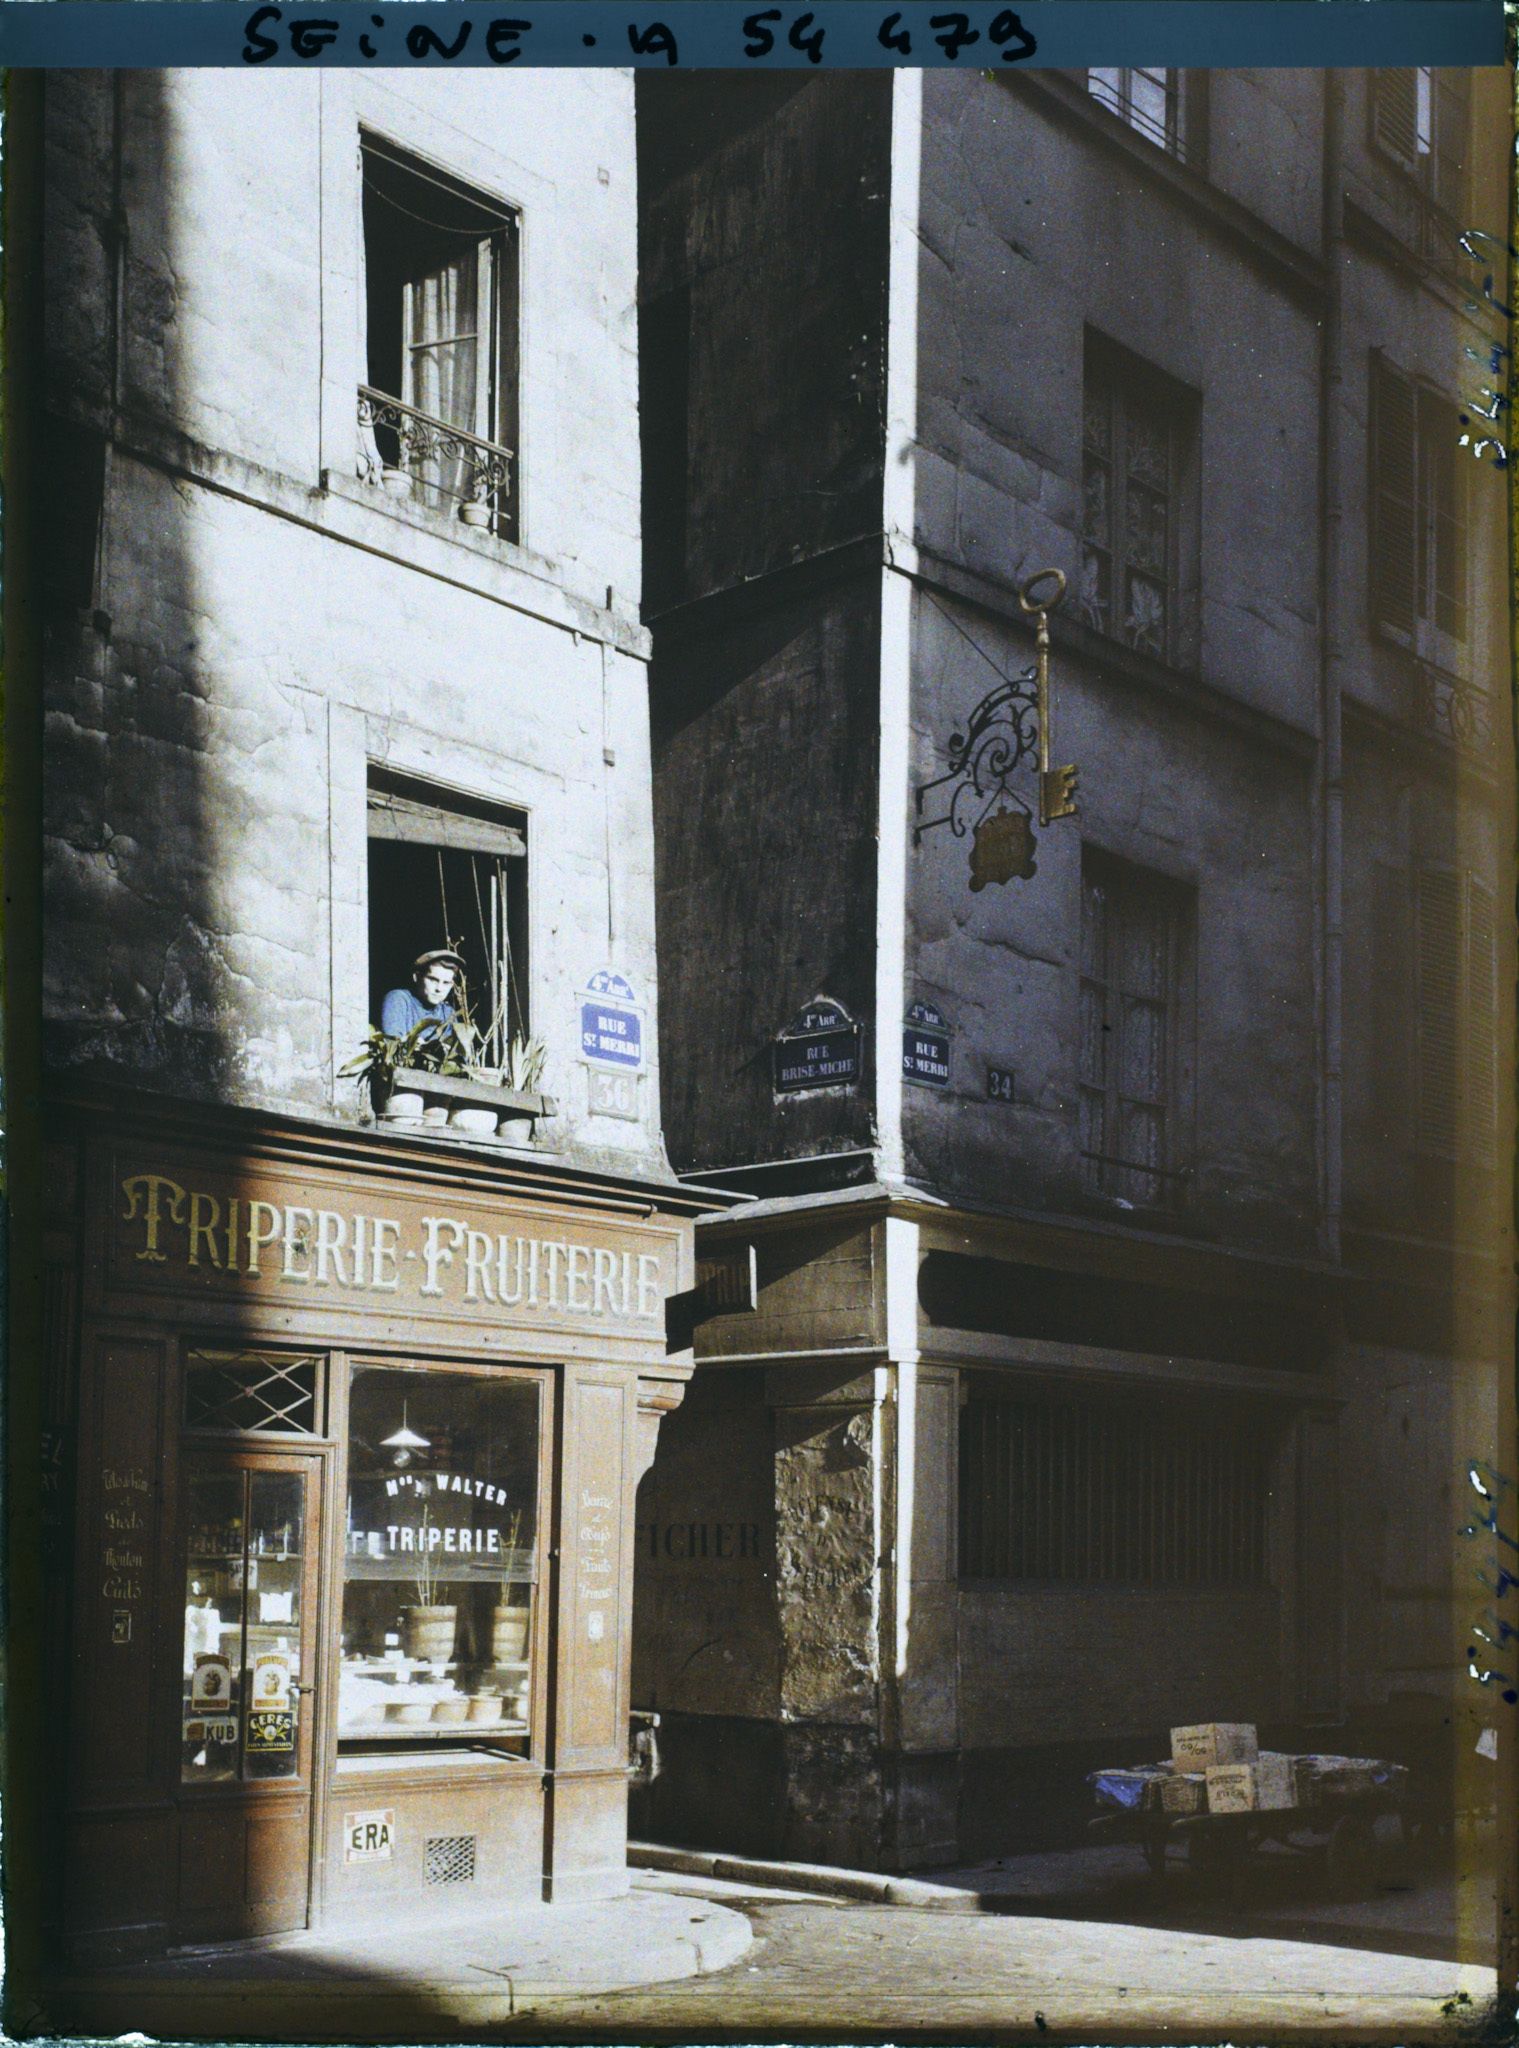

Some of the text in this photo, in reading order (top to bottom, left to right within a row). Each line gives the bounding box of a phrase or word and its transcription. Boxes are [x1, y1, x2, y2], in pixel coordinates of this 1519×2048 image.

[876, 8, 1038, 63] 479
[598, 1015, 627, 1036] RUE
[599, 1035, 640, 1059] MERRI
[806, 1044, 831, 1060] RUE
[915, 1041, 939, 1059] RUE
[915, 1057, 950, 1078] MERRI
[597, 1074, 630, 1111] 36
[990, 1071, 1012, 1099] 34
[435, 1473, 508, 1507] WALTER
[386, 1525, 499, 1553] TRIPERIE
[206, 1725, 236, 1741] KUB
[351, 1823, 390, 1851] ERA
